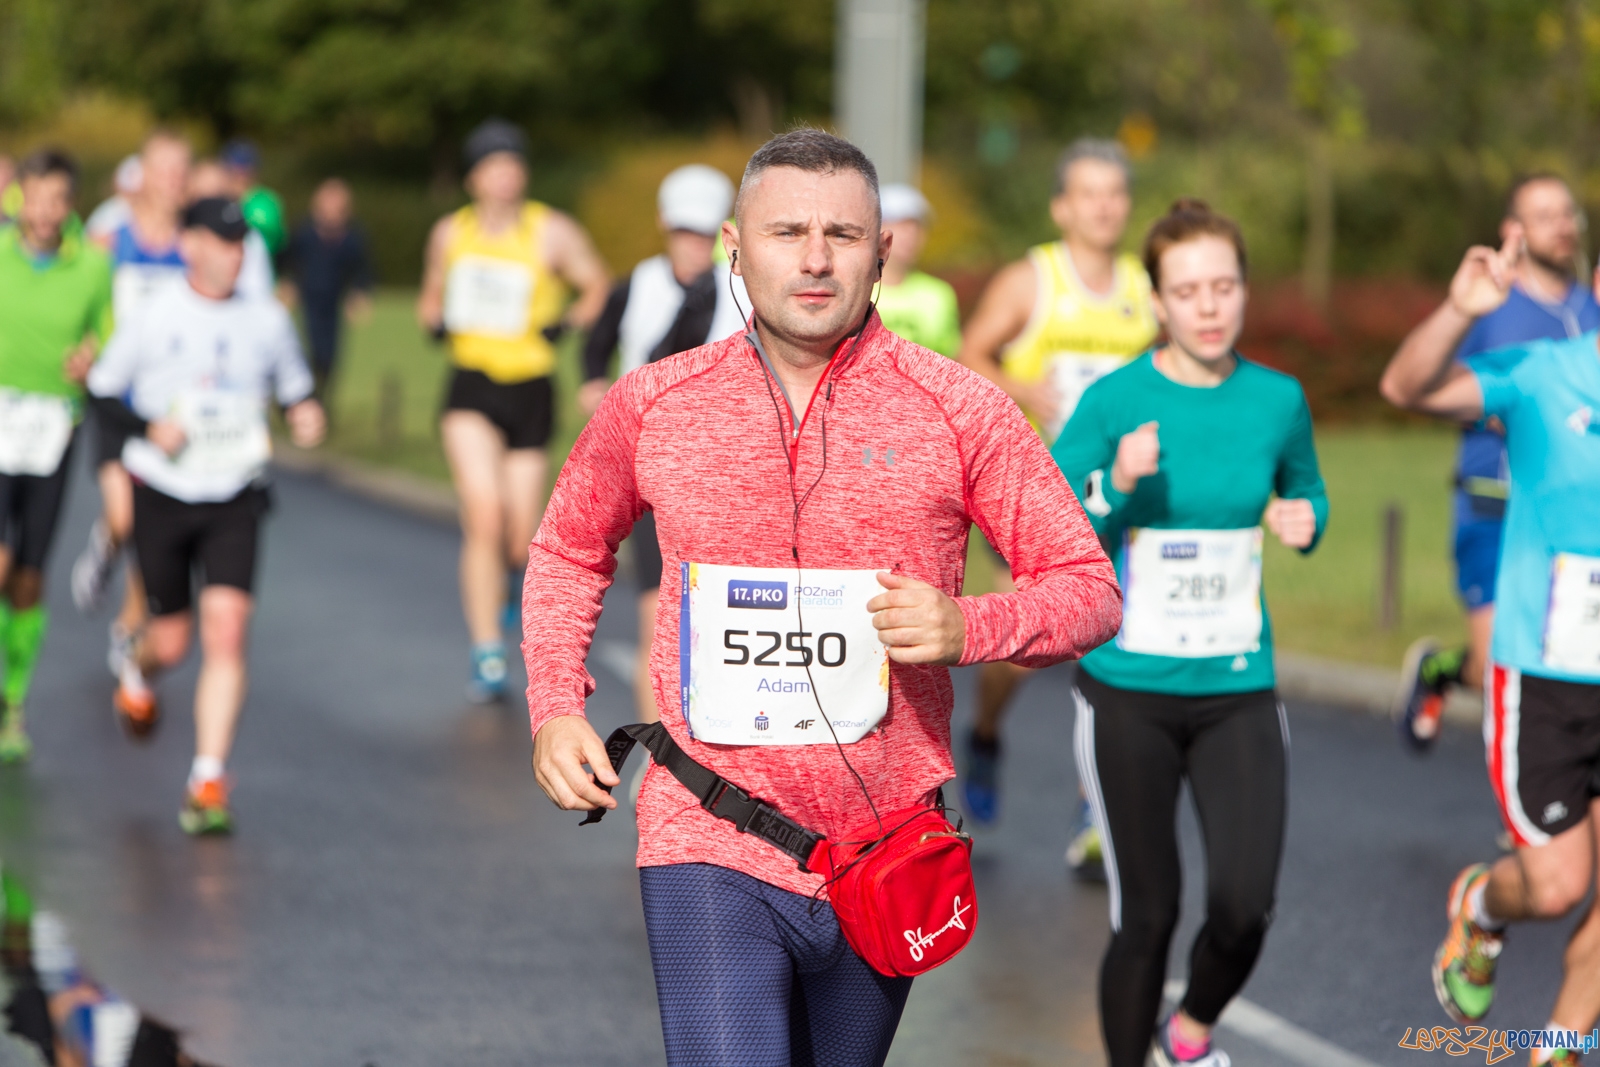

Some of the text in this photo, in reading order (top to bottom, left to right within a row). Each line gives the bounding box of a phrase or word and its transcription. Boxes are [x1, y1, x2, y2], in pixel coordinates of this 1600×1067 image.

[1167, 573, 1227, 602] 289
[724, 629, 847, 668] 5250
[757, 678, 811, 693] Adam
[794, 719, 816, 730] 4F
